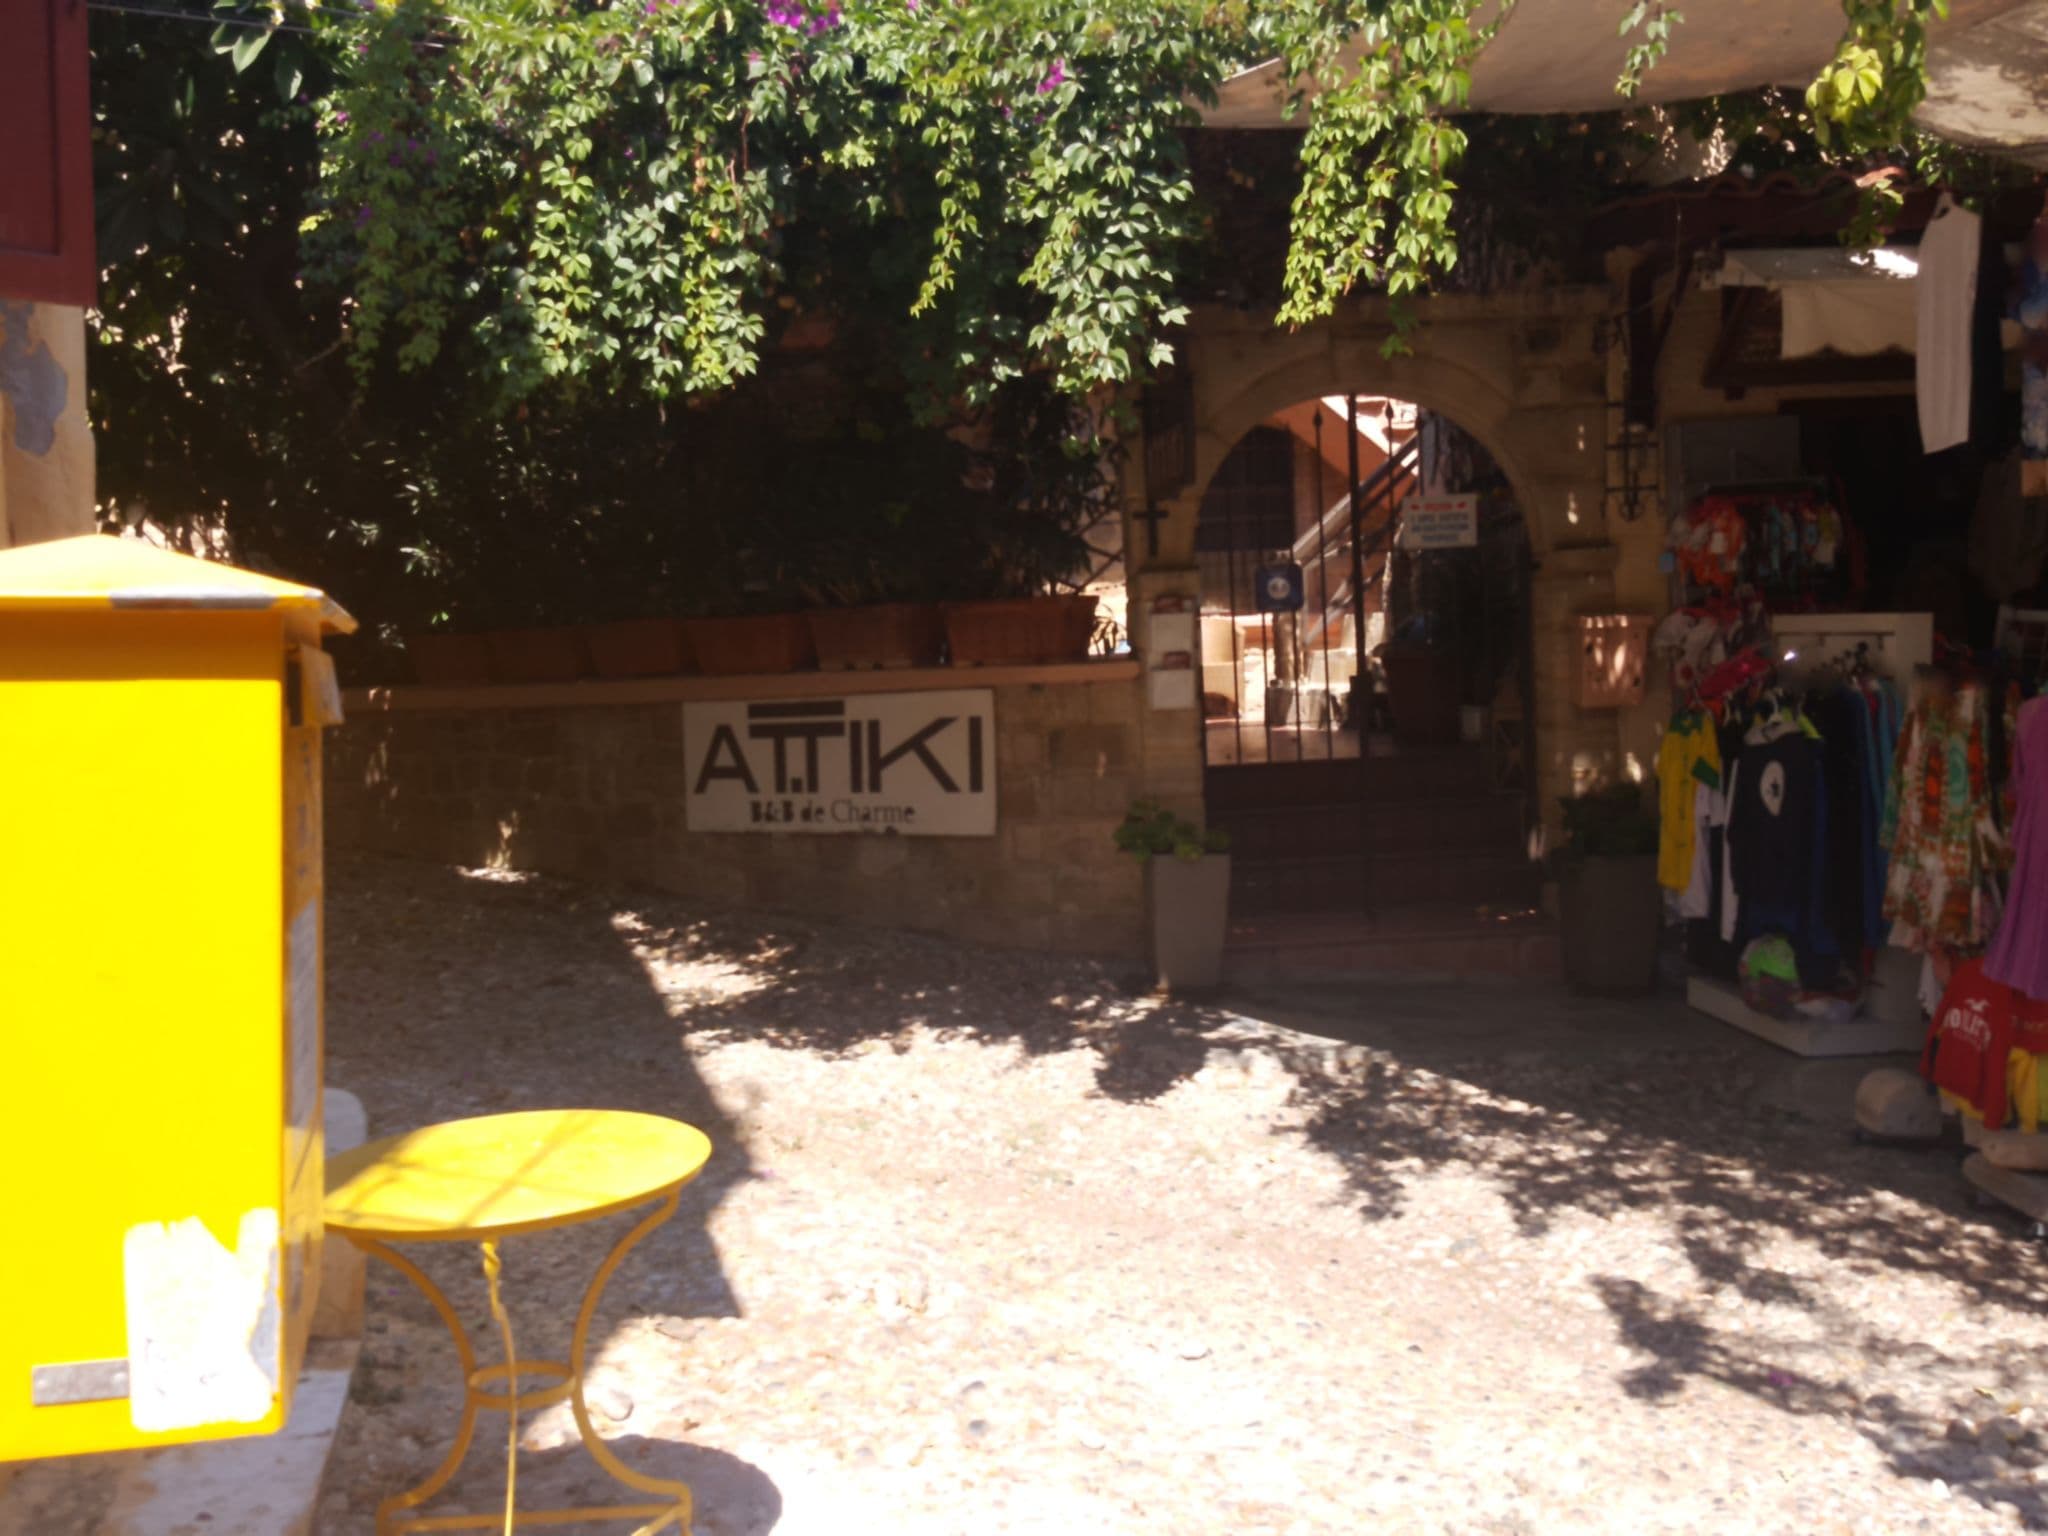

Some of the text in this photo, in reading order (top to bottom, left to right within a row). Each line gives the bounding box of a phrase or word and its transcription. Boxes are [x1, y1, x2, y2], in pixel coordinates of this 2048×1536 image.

[694, 700, 983, 794] ATTIKI
[801, 800, 825, 823] de
[829, 800, 915, 823] Charme
